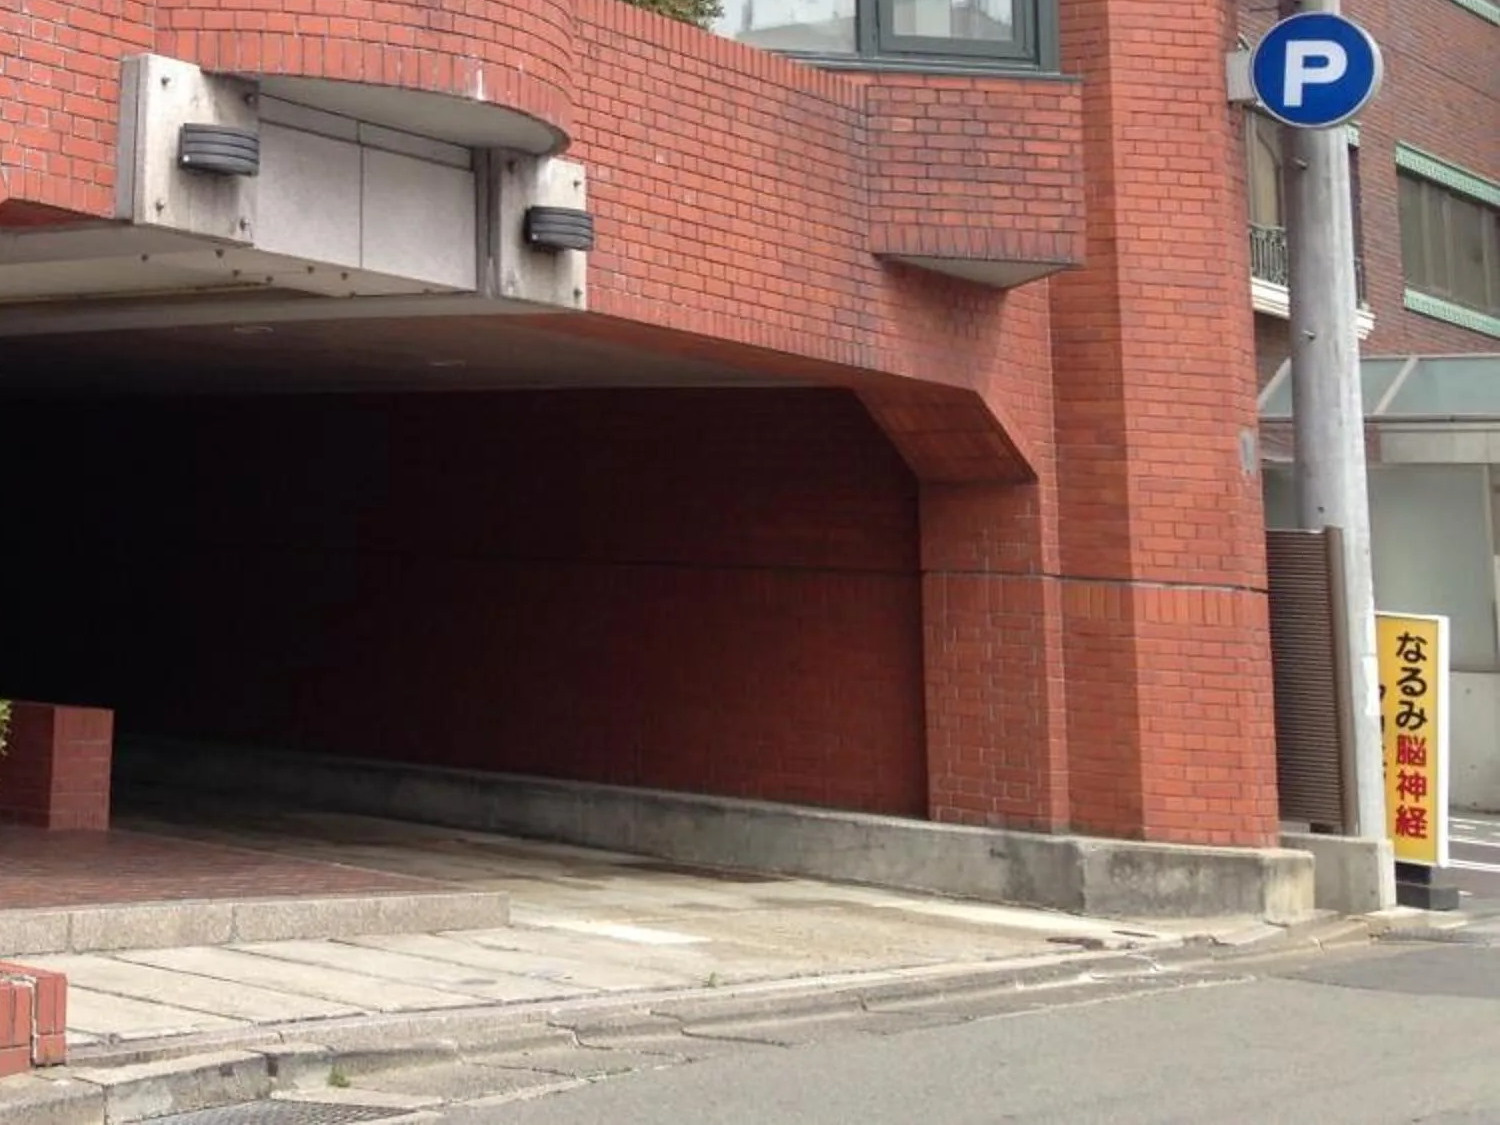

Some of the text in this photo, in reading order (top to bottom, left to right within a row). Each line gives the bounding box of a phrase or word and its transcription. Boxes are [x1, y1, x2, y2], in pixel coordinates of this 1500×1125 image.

[1283, 40, 1348, 107] P
[1395, 631, 1429, 840] なるみ脳神経
